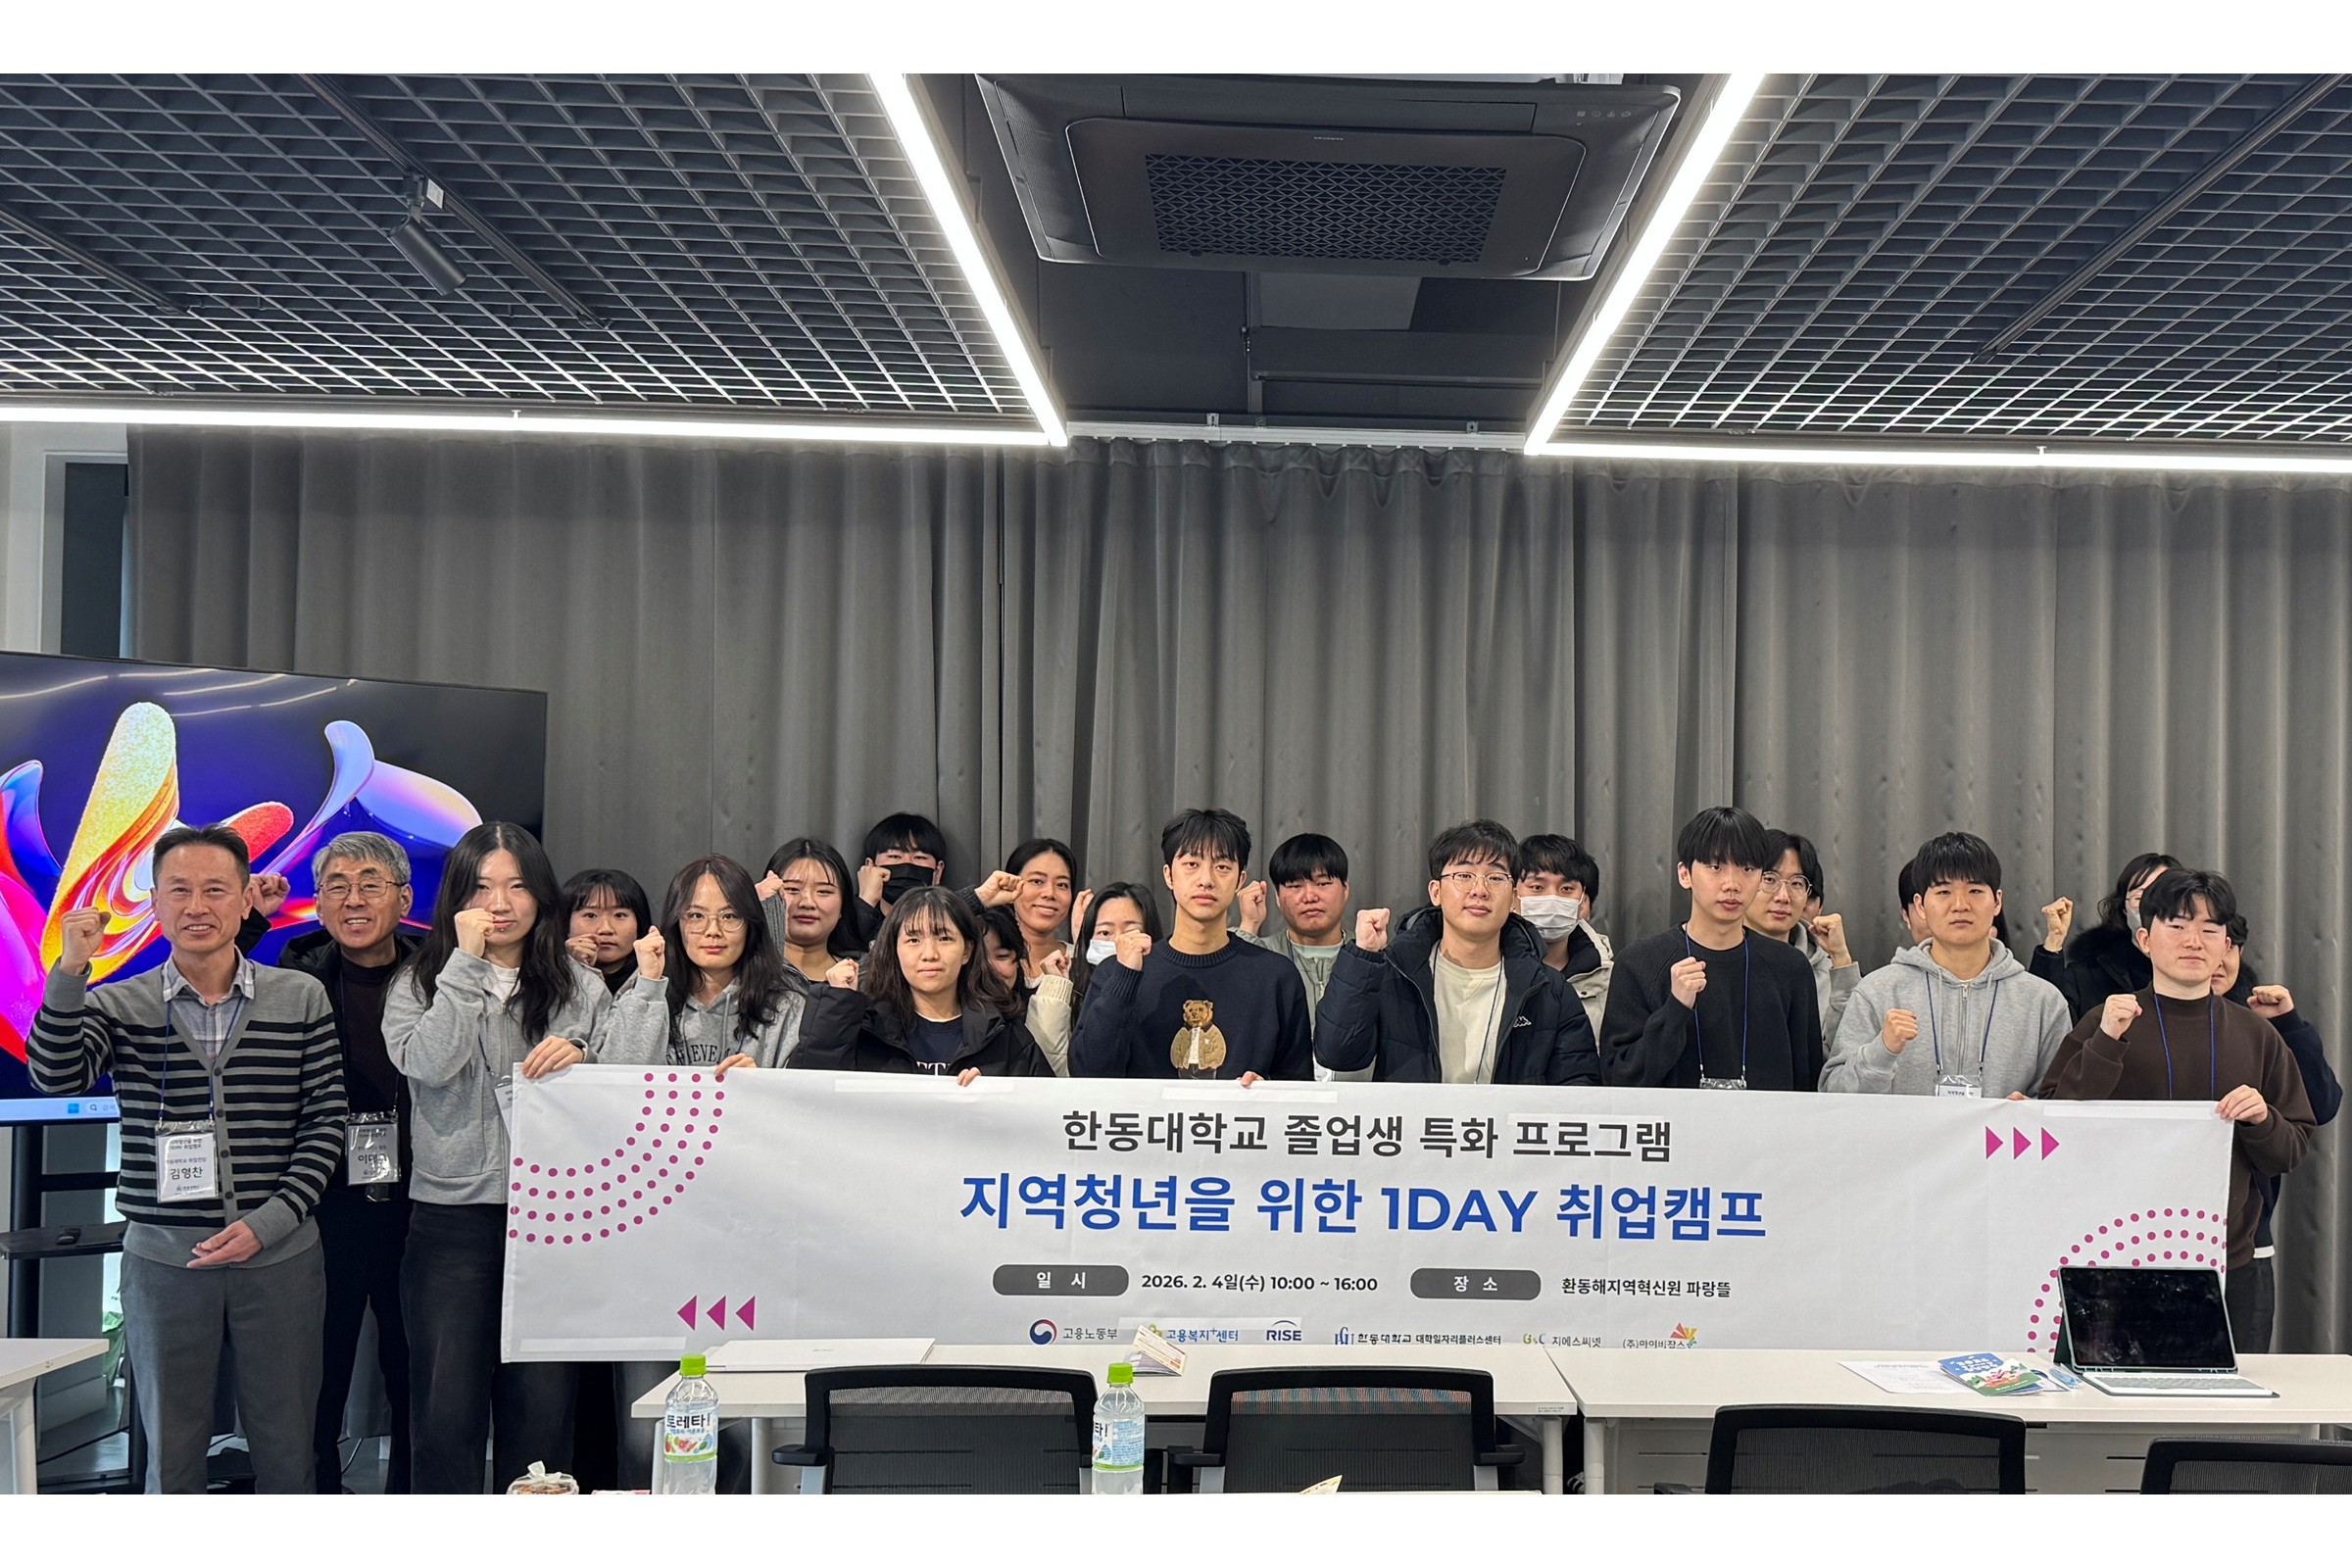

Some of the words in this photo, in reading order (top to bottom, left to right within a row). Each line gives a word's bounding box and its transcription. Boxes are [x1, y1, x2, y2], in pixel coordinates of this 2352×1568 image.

[1063, 1111, 1267, 1153] 한동대학교
[1285, 1115, 1402, 1156] 졸업생
[1420, 1118, 1498, 1158] 특화
[1513, 1121, 1670, 1162] 프로그램
[960, 1173, 1235, 1232] 지역청년을
[1257, 1178, 1362, 1233] 위한
[1382, 1188, 1538, 1232] 1DAY
[1557, 1184, 1766, 1241] 취업캠프
[1142, 1275, 1188, 1289] 2026.
[1193, 1275, 1206, 1289] 2.
[1212, 1274, 1265, 1292] 4일(수)
[1271, 1277, 1314, 1290] 10:00
[1335, 1278, 1377, 1291] 16:00
[1562, 1278, 1680, 1296] 환동해지역혁신원
[1687, 1281, 1731, 1298] 파랑뜰
[1266, 1330, 1302, 1341] RISE
[1357, 1334, 1411, 1345] 한동대학교
[1416, 1334, 1501, 1346] 대학일자리플러스센터
[1552, 1337, 1601, 1348] 지에스씨넷
[666, 1413, 710, 1429] 토레타!
